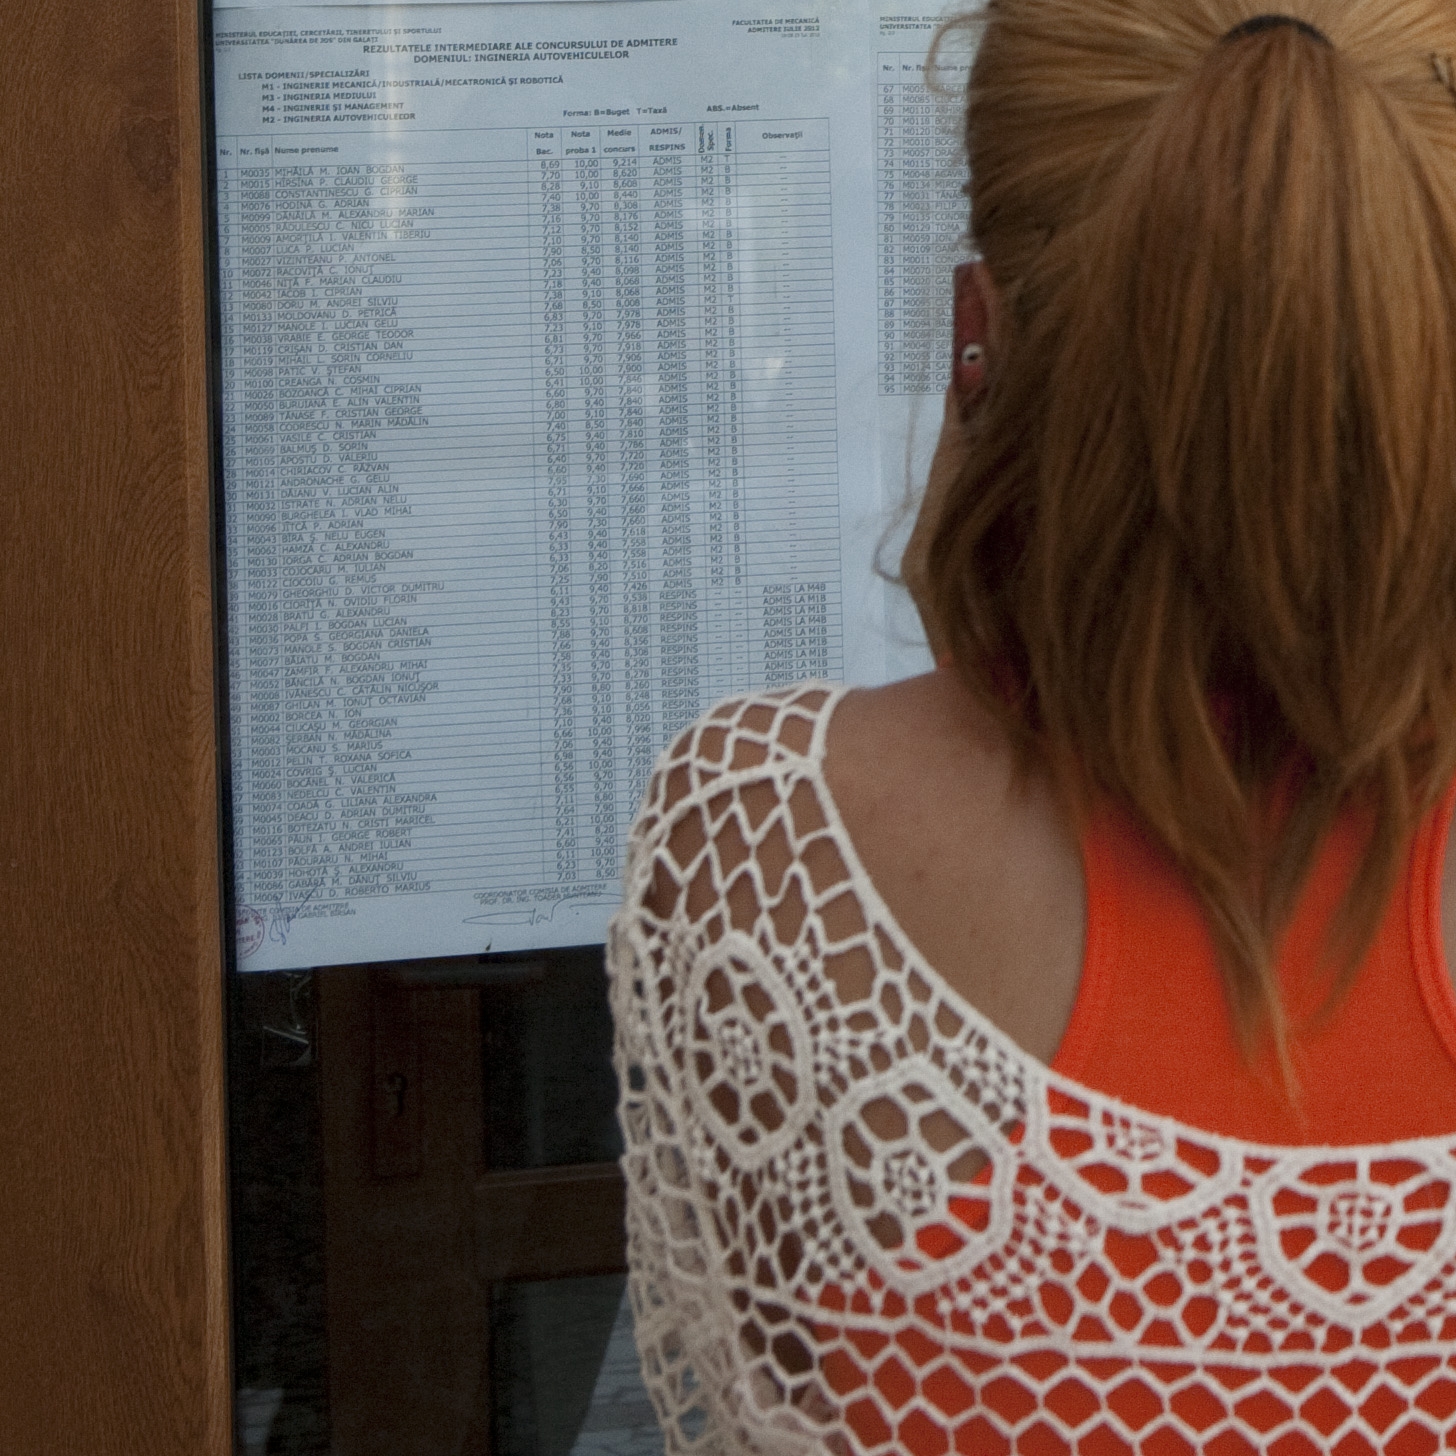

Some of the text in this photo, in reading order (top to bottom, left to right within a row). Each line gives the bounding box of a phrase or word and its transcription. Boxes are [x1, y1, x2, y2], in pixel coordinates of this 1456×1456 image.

[784, 16, 820, 25] MECANICĂ
[362, 38, 677, 53] REZULTATELE INTERMEDIARE ALE CONCURSULUI DE ADMITERE
[413, 50, 629, 64] DOMENIUL: INGINERIA AUTOVEHICULELOR
[238, 68, 369, 80] LISTA DOMENII/SPECIALIZĂRI
[282, 82, 330, 90] INGINERIE
[519, 75, 563, 85] ROBOTICĂ
[282, 93, 331, 101] INGINERIA
[332, 92, 376, 100] MEDIULUI
[283, 104, 330, 112] INGINERIE
[344, 103, 403, 111] MANAGEMENT
[262, 116, 275, 124] M2
[283, 115, 331, 123] INGINERIA
